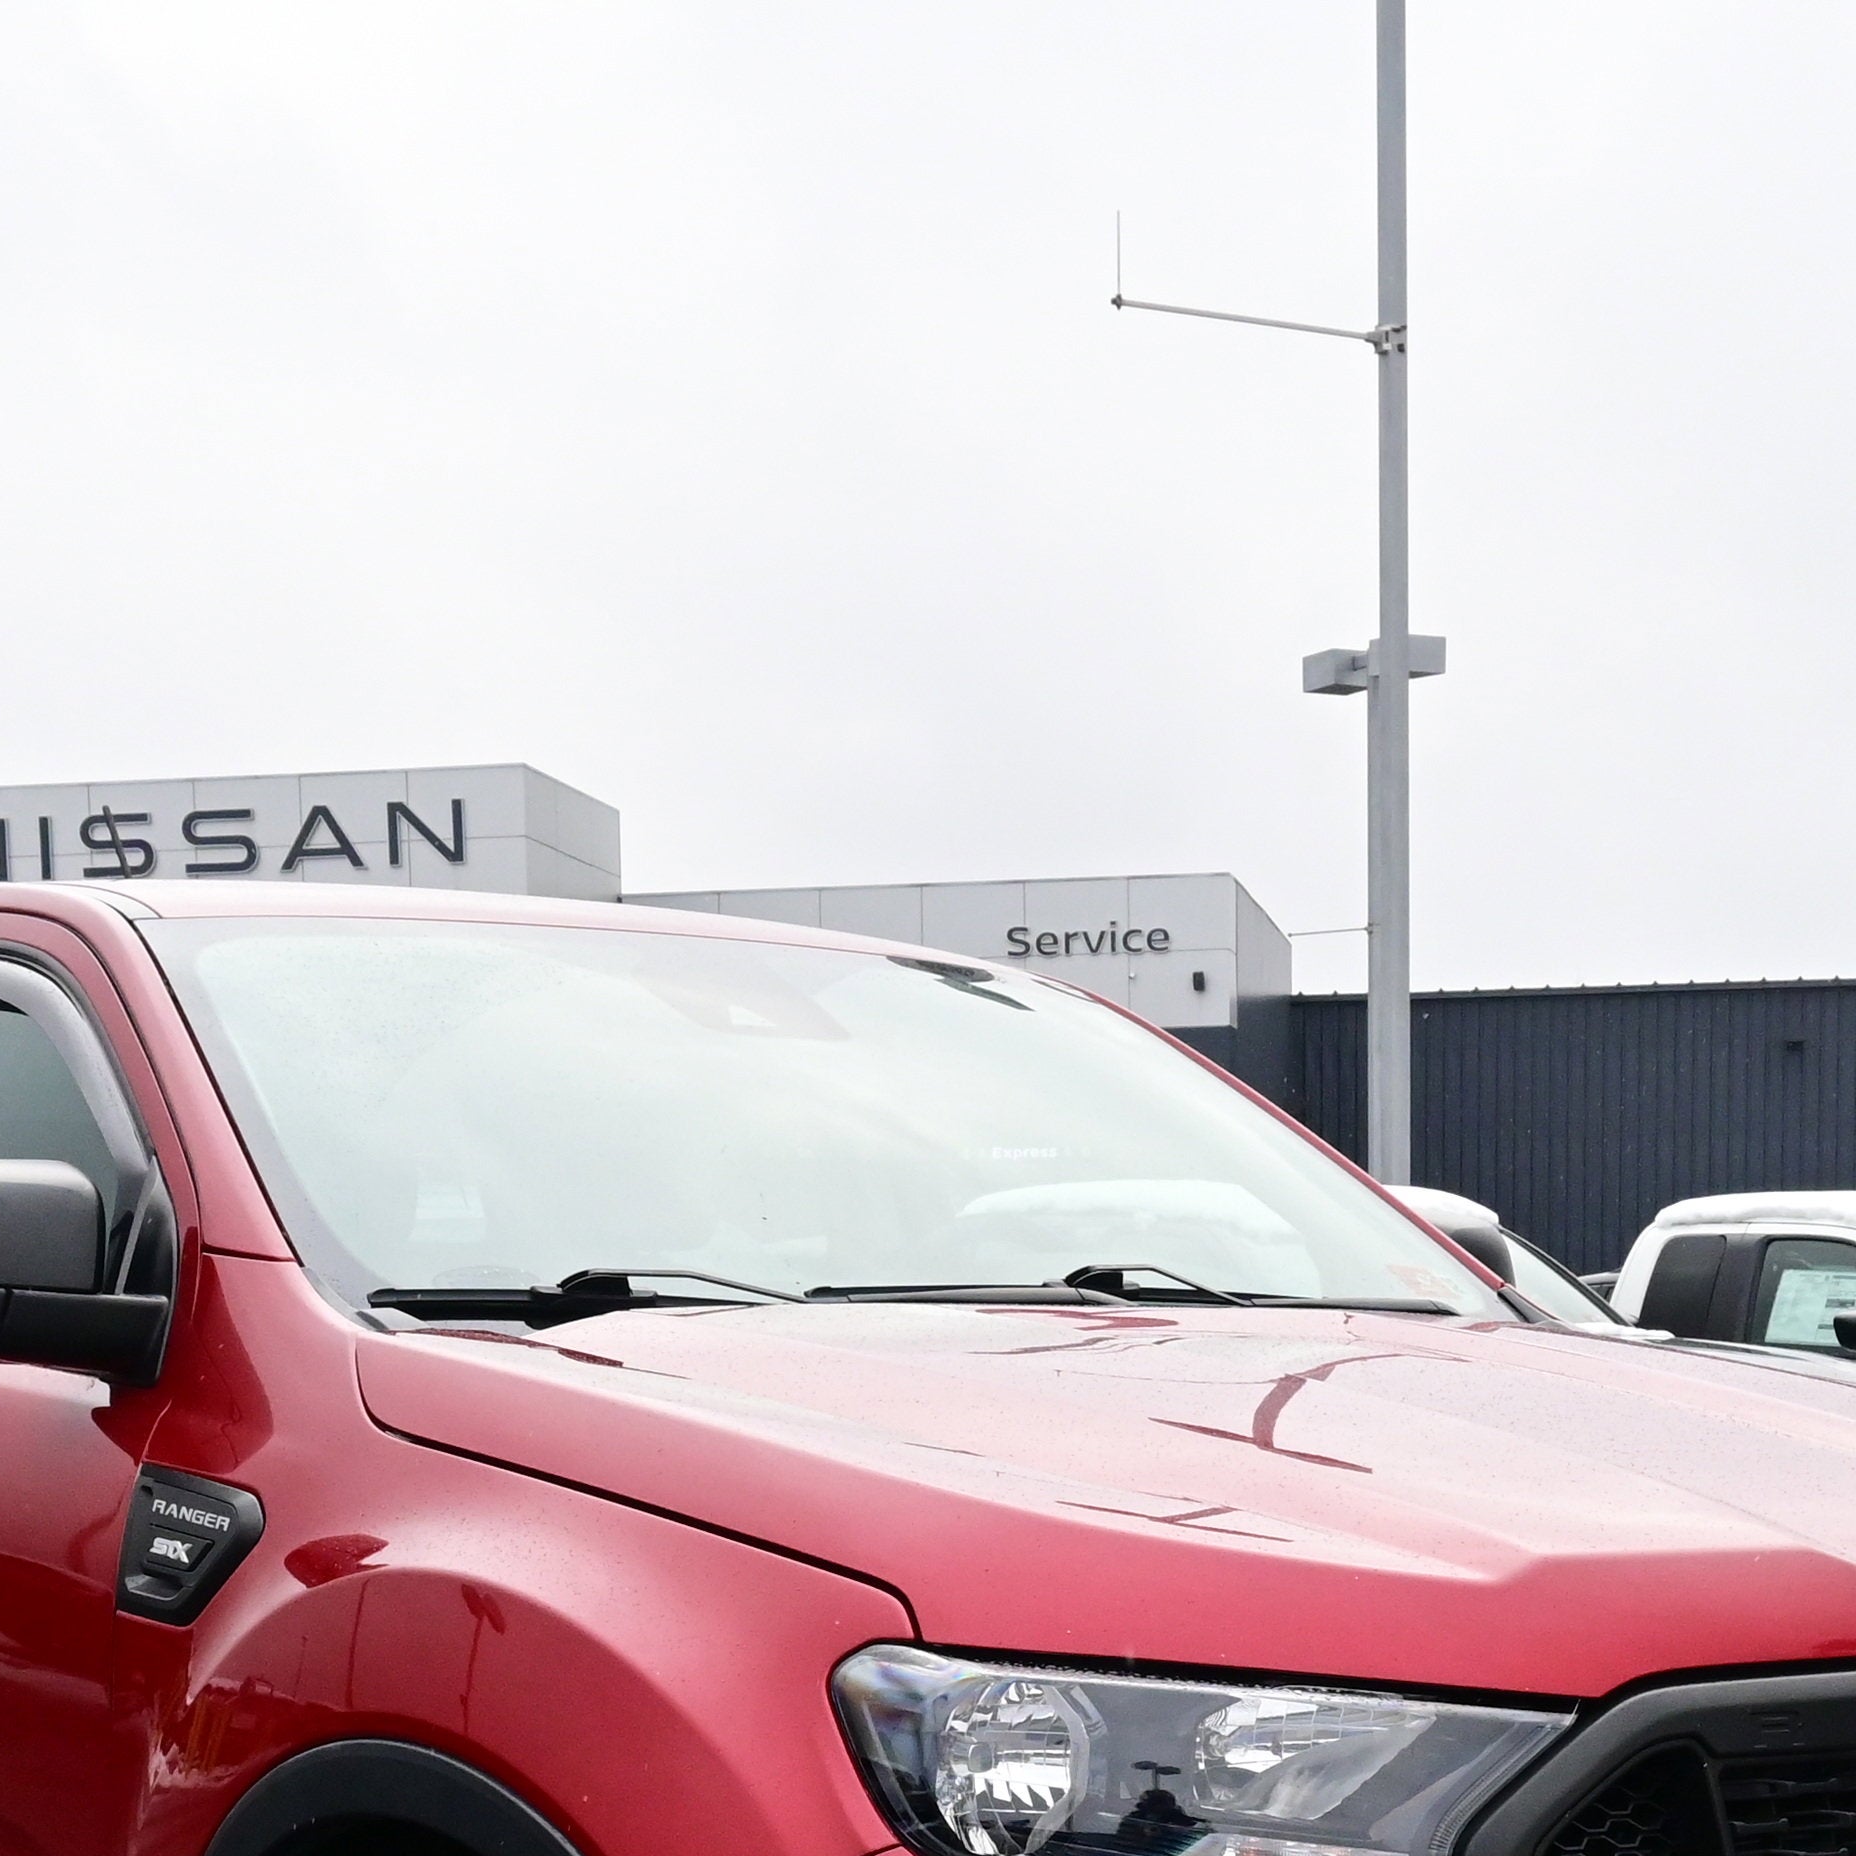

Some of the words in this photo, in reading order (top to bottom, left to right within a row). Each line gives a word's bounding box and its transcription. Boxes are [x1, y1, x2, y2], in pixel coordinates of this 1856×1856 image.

[1007, 921, 1170, 956] Service
[992, 1147, 1057, 1159] Express
[152, 1499, 231, 1531] RANGER
[149, 1537, 193, 1563] STX
